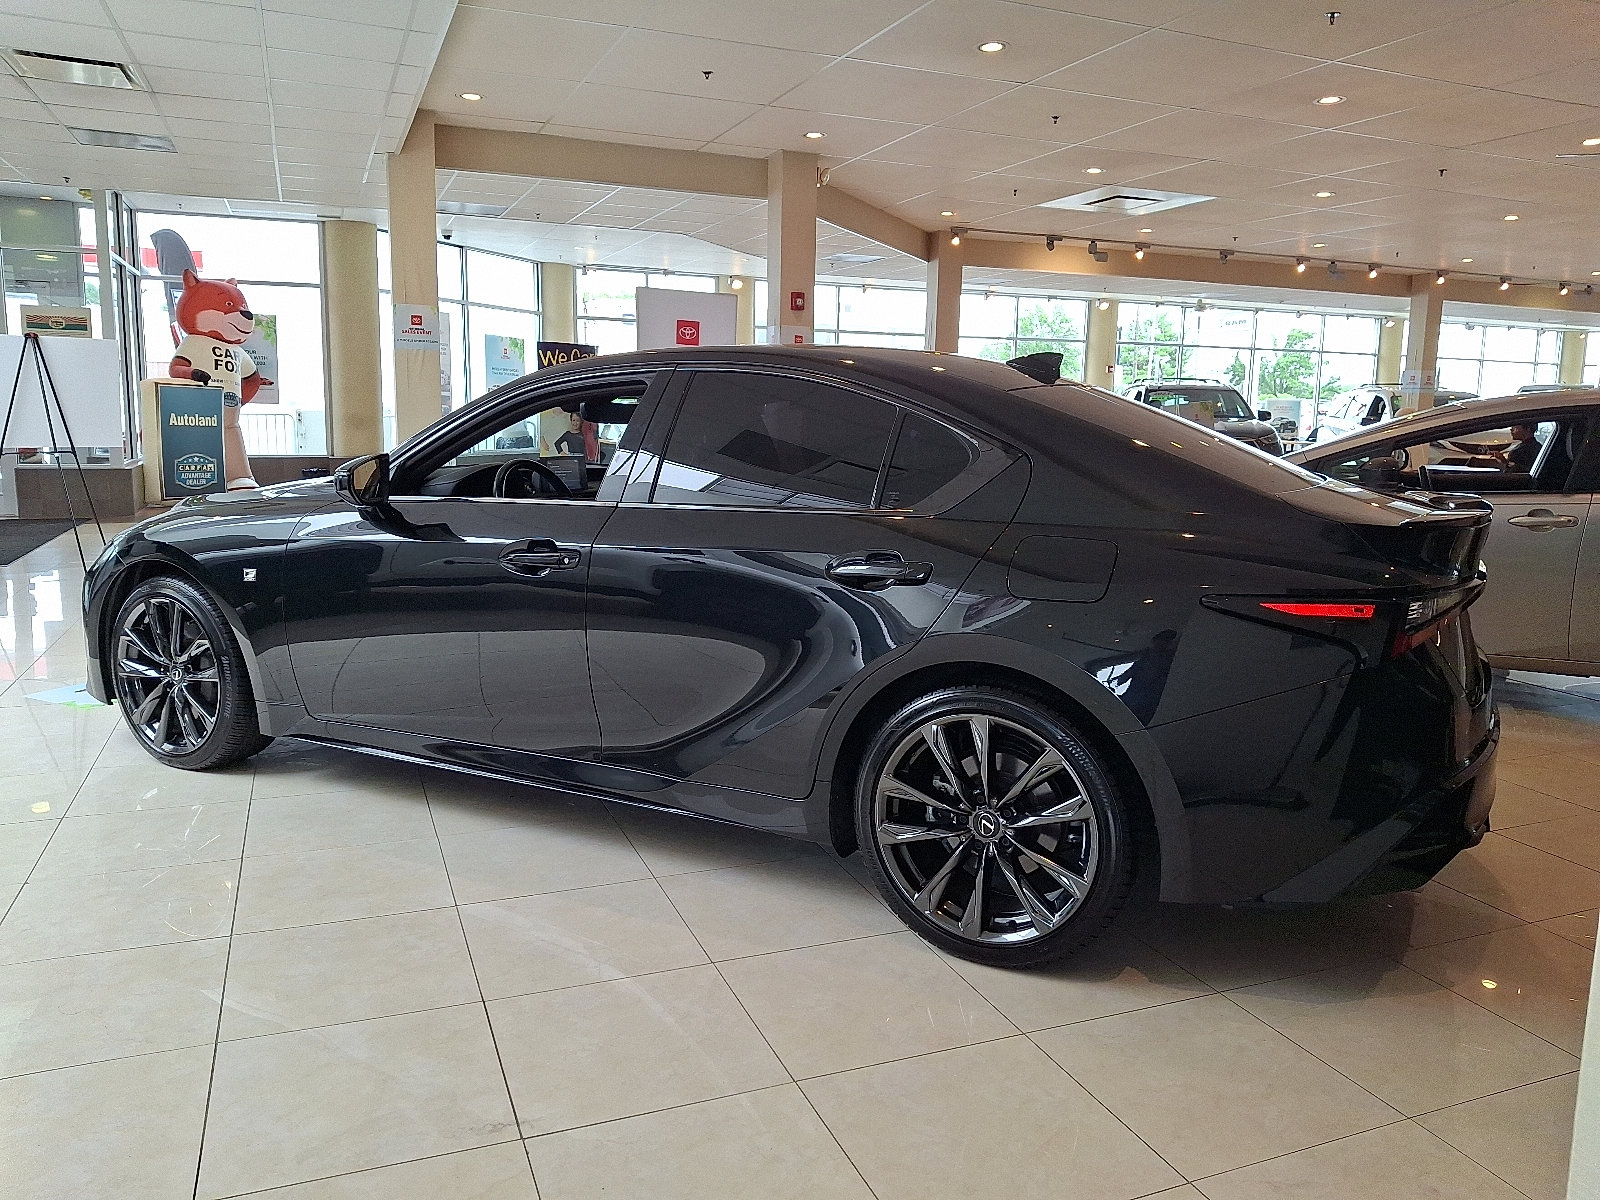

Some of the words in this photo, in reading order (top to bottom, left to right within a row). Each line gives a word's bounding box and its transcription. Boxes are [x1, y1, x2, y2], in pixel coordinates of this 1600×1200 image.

[538, 348, 568, 367] We
[169, 412, 218, 427] Autoland
[178, 464, 215, 472] CARFAX
